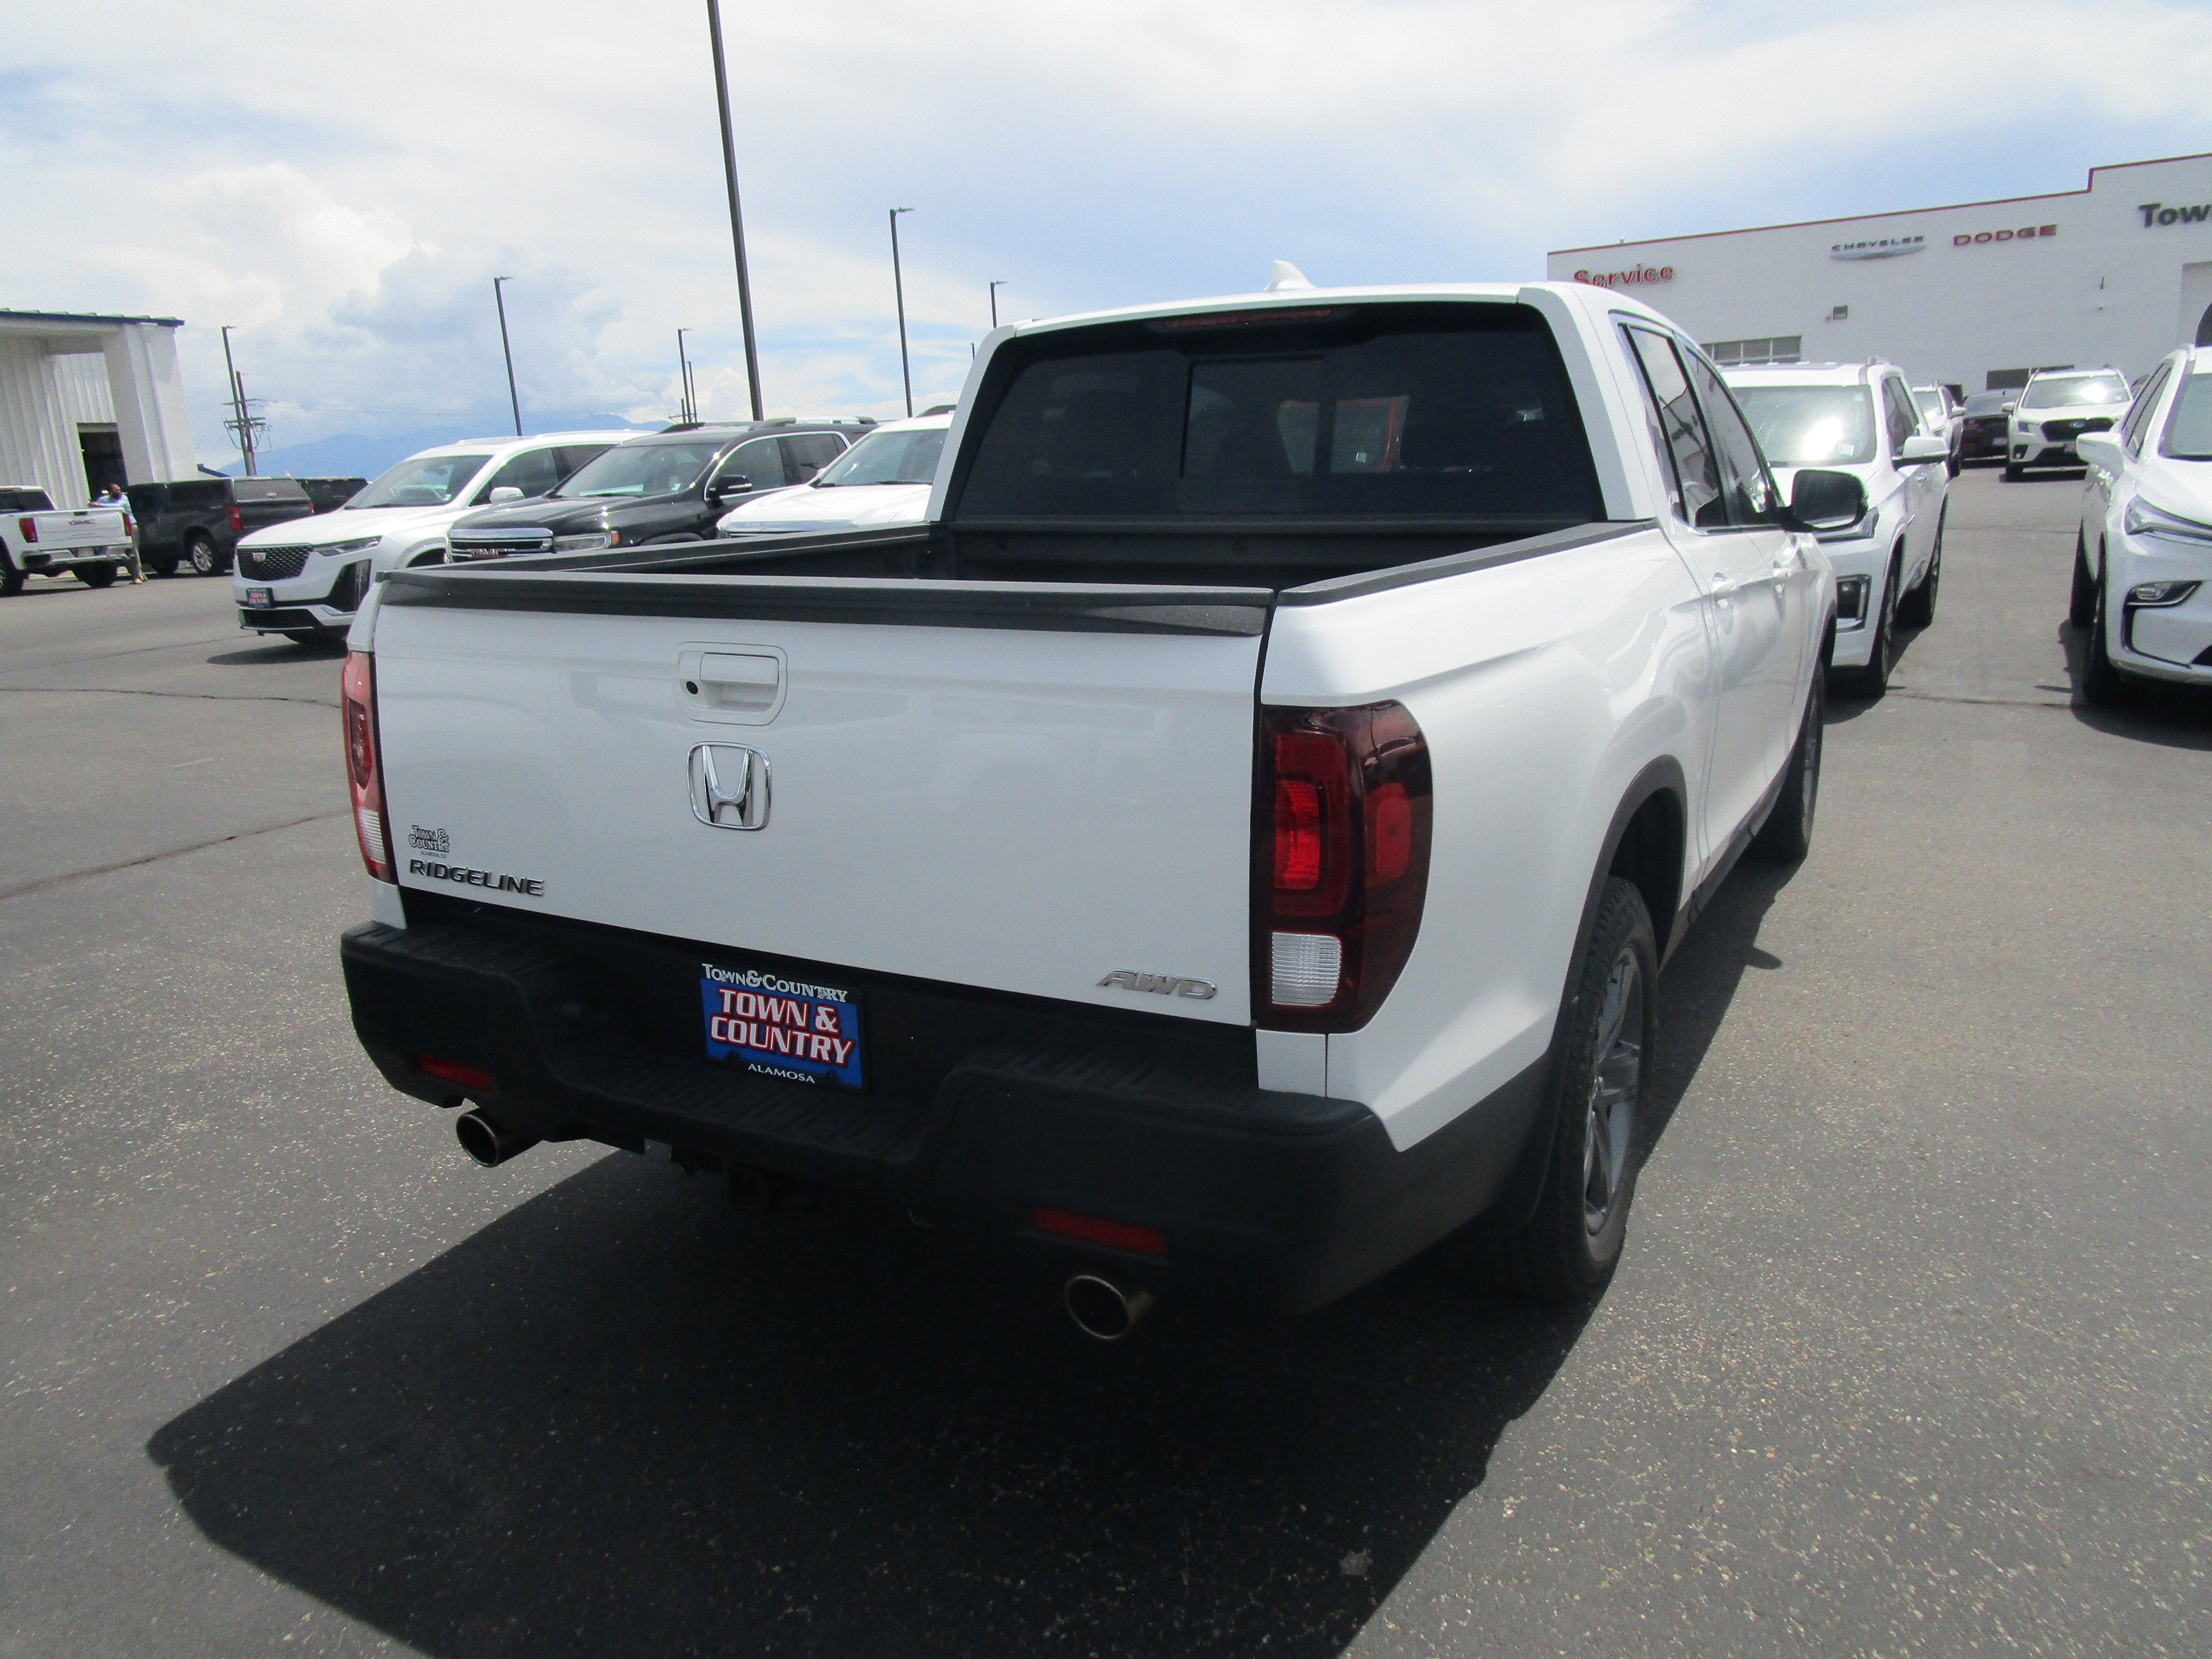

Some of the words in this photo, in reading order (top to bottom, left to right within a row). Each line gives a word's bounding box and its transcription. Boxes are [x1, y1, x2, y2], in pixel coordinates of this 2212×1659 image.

[1832, 235, 1924, 252] CHRYSLER
[1954, 224, 2057, 246] DODGE
[1574, 262, 1674, 288] Service
[471, 548, 507, 559] GMC
[410, 858, 544, 896] RIDGELINE
[1095, 968, 1217, 1000] AWD
[719, 989, 807, 1027] TOWN
[815, 1006, 840, 1033] &
[711, 1016, 853, 1064] COUNTRY
[748, 1063, 816, 1084] ALAMOSA
